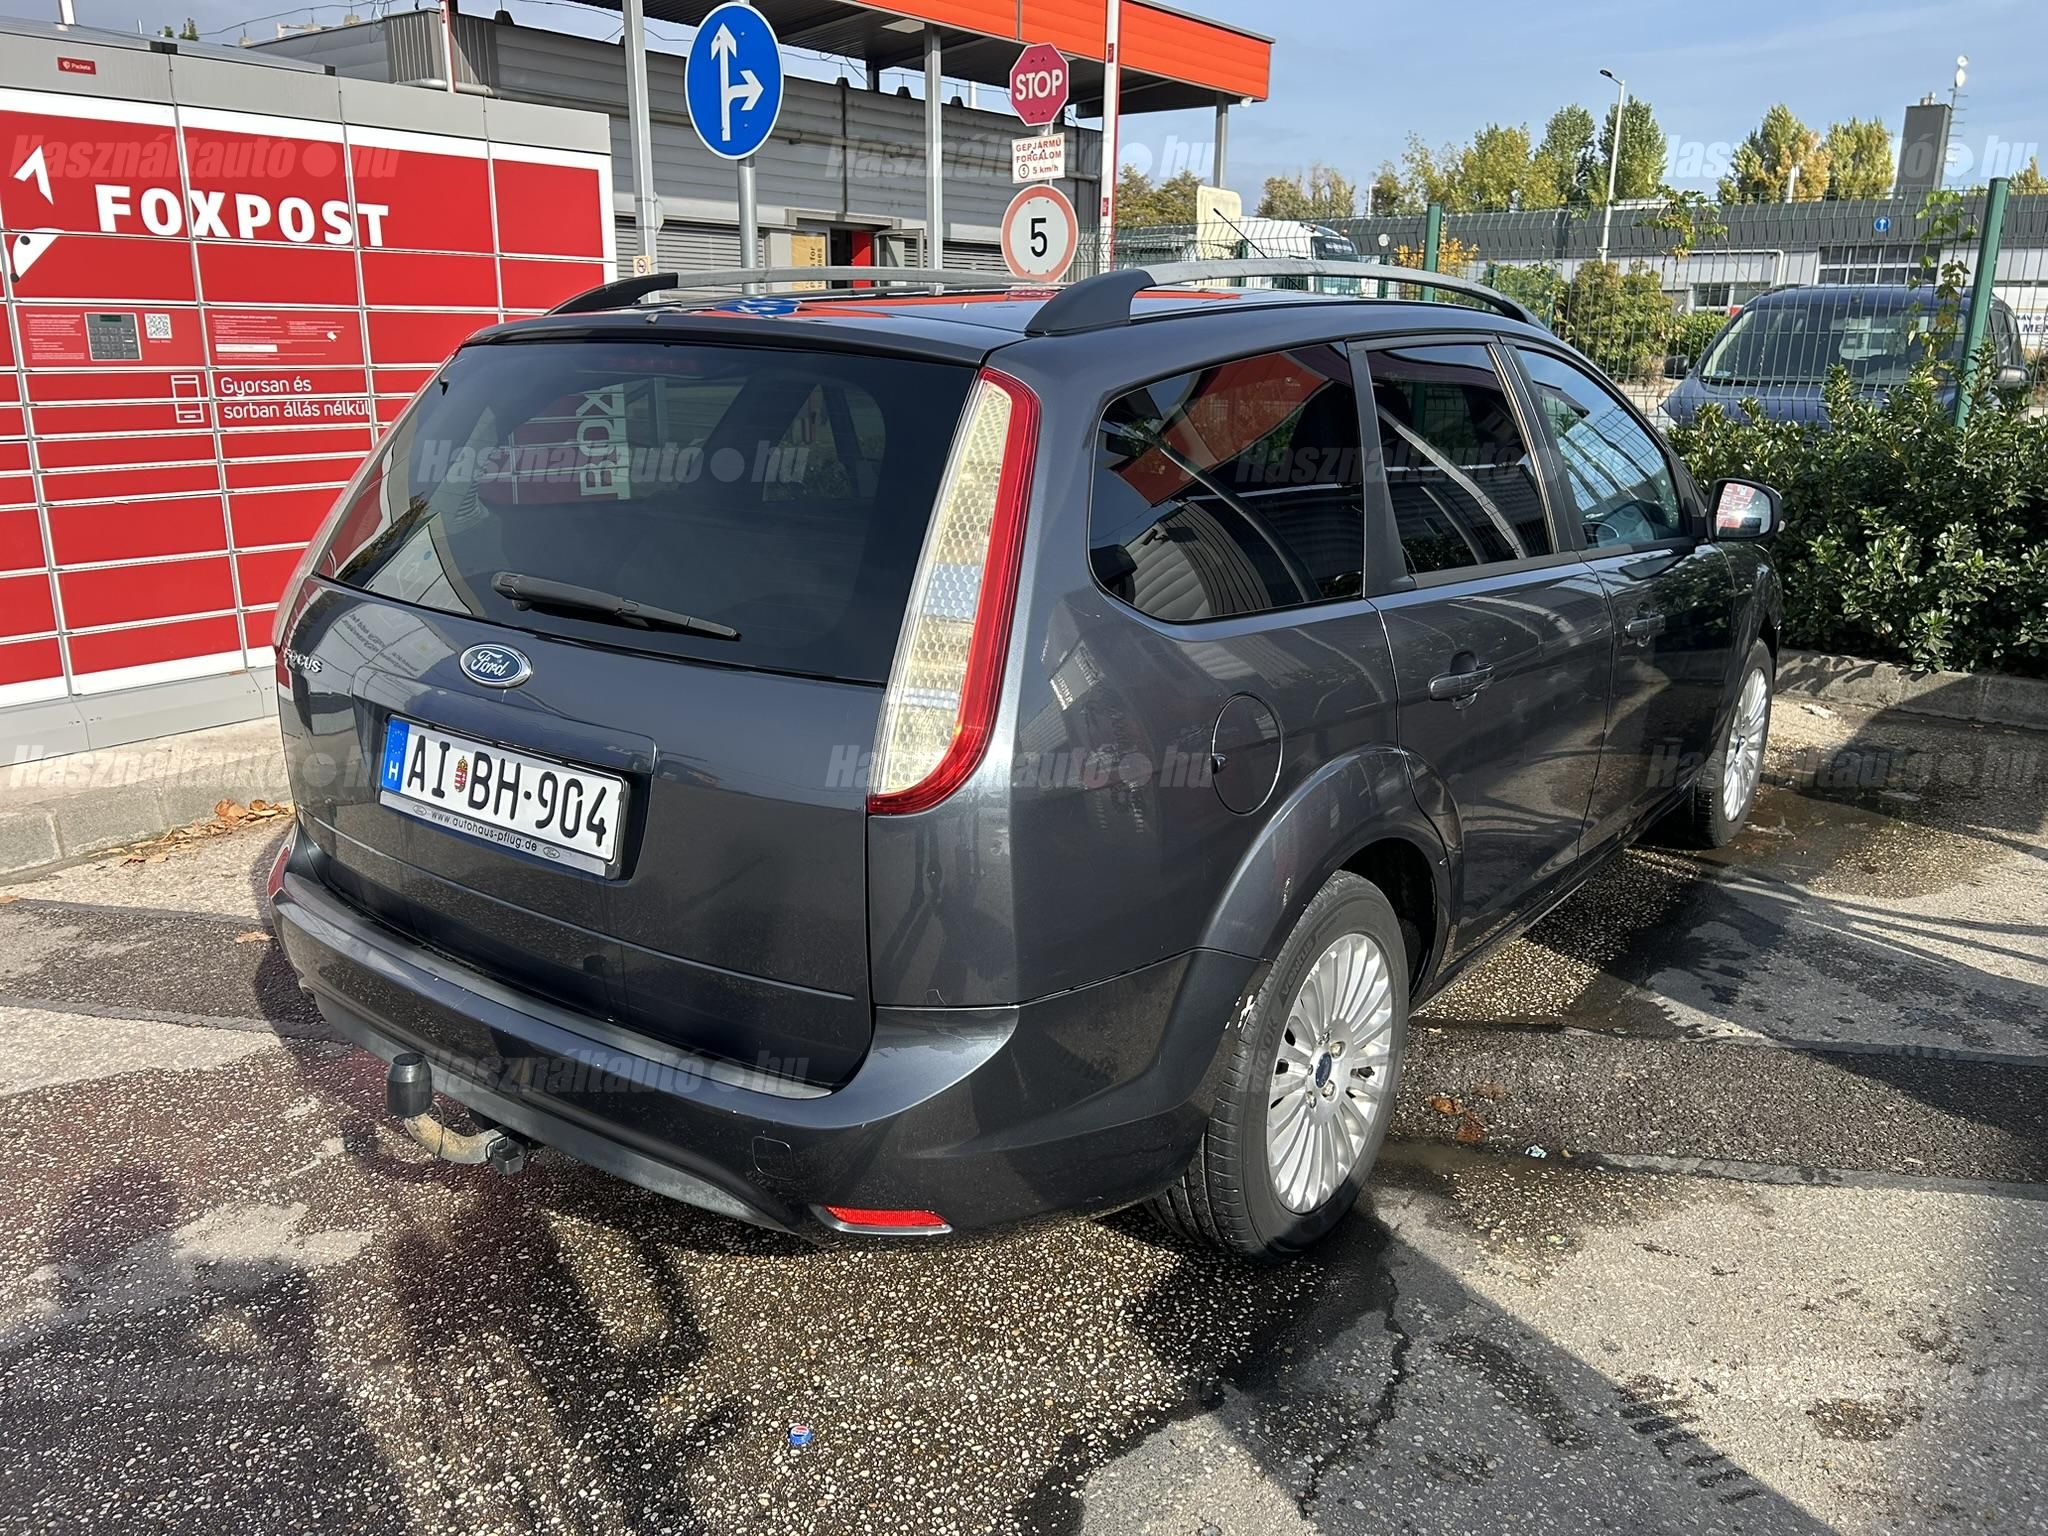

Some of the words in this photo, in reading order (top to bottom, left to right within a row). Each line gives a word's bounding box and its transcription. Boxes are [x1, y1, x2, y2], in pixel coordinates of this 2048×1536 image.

[1015, 68, 1063, 101] STOP
[1016, 150, 1061, 164] FORGALOM
[1033, 166, 1038, 175] 5
[1040, 163, 1059, 174] km/h
[94, 184, 390, 247] FOXPOST
[1030, 217, 1048, 258] 5
[220, 376, 289, 398] Gyorsan
[292, 376, 312, 392] és
[224, 402, 279, 419] sorban
[283, 402, 321, 418] állás
[324, 401, 371, 418] nélkül
[471, 649, 511, 677] Ford
[388, 760, 399, 782] H
[407, 735, 451, 799] AI
[431, 811, 538, 852] www.autohaus-pflug.de
